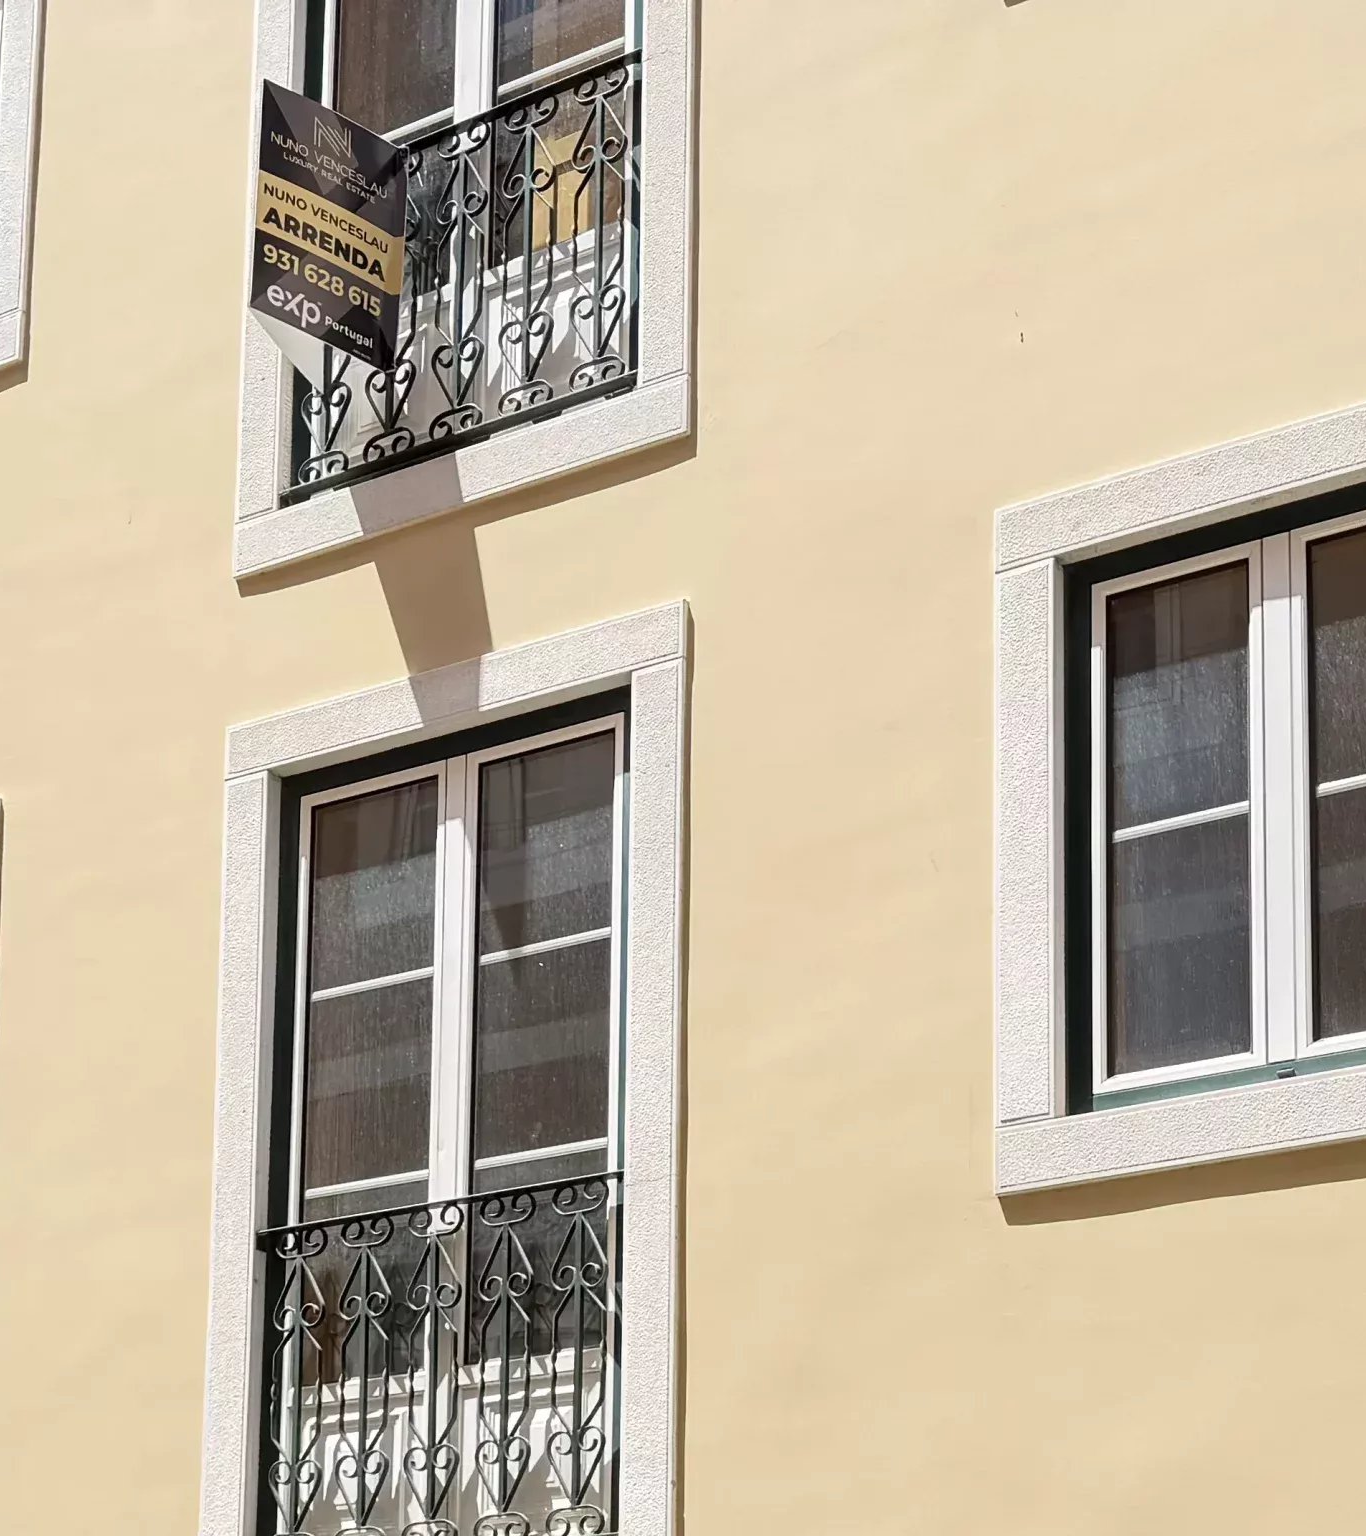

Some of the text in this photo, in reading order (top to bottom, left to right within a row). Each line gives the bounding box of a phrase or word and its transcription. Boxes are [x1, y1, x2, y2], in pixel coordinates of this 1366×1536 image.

[270, 131, 388, 199] NUNO VENCESLAU
[283, 152, 376, 204] LUXURY REAL ESTATE
[263, 207, 386, 282] ARRENDA
[264, 183, 389, 254] NUNO VENCESLAU
[263, 244, 381, 317] 931 628 615
[325, 316, 373, 349] Portugal
